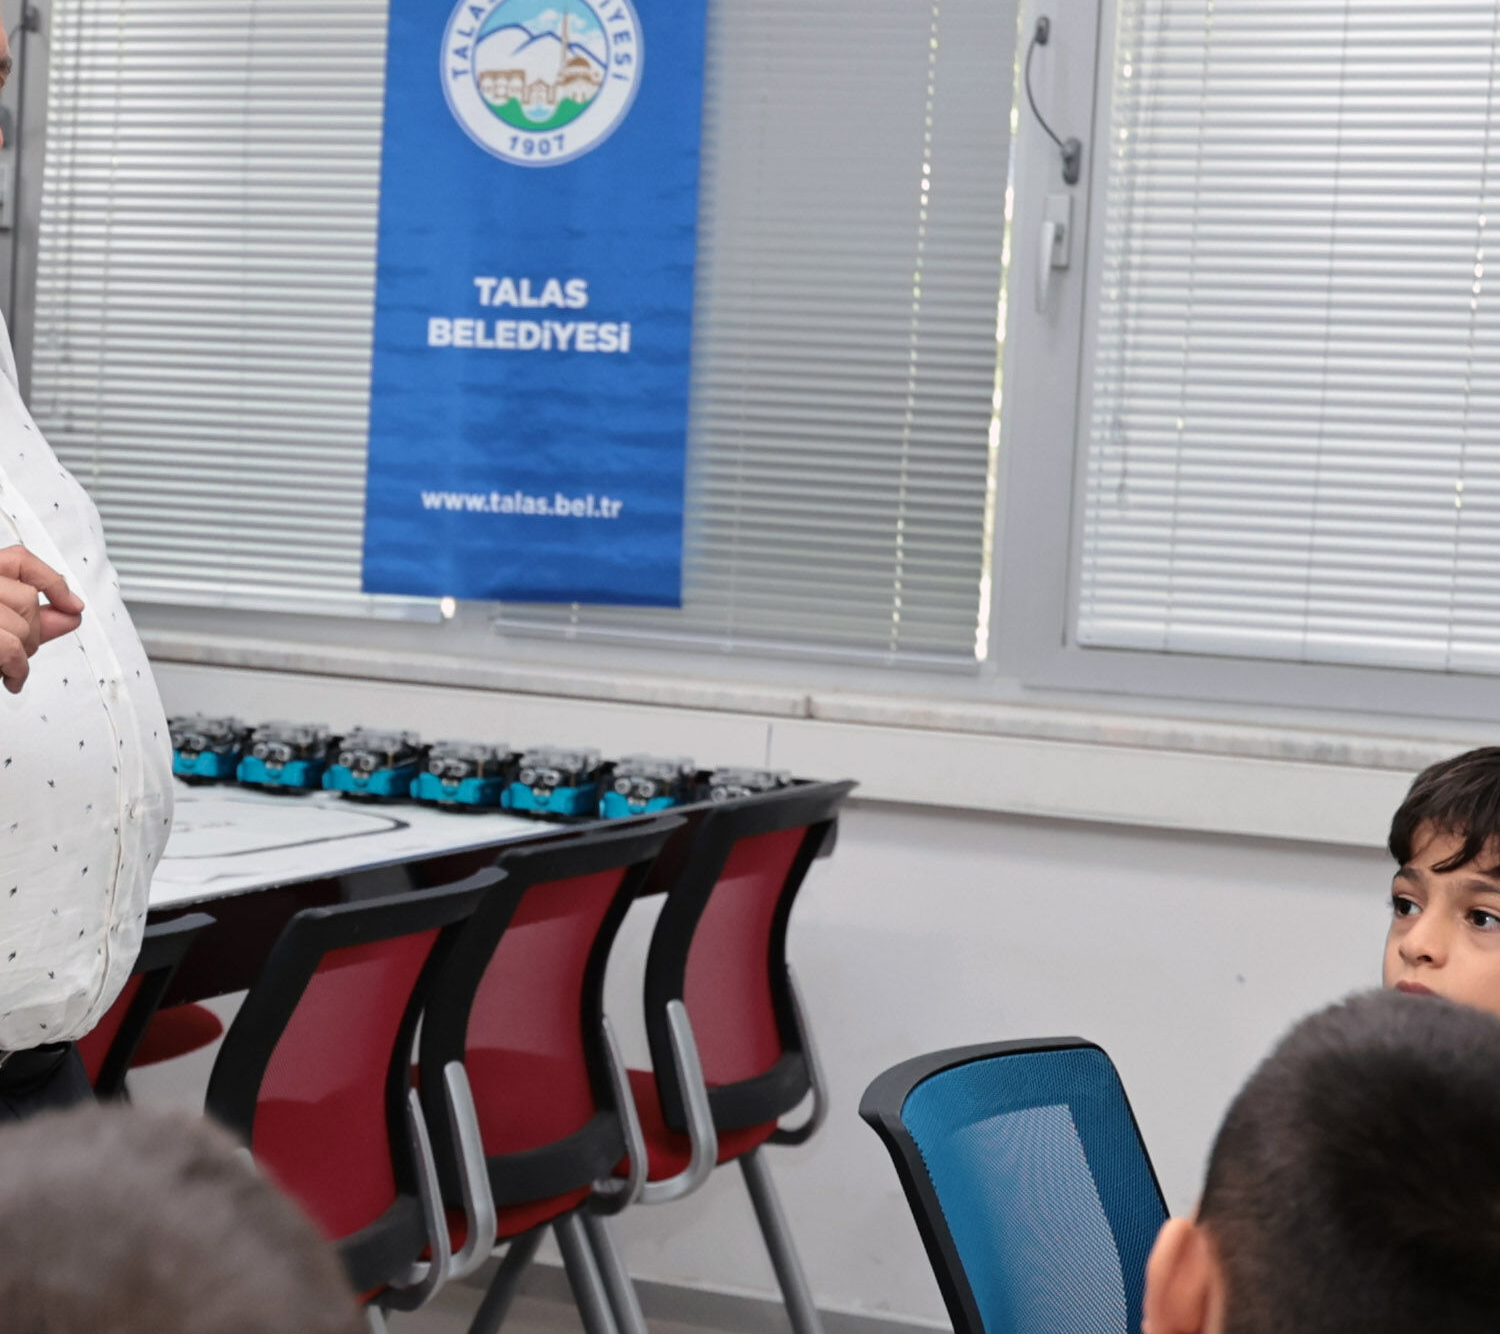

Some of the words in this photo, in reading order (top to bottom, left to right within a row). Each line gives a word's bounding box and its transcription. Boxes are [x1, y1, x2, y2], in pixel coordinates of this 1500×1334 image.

[508, 133, 566, 156] 1907
[474, 276, 589, 310] TALAS
[420, 490, 623, 519] www.talas.bel.tr
